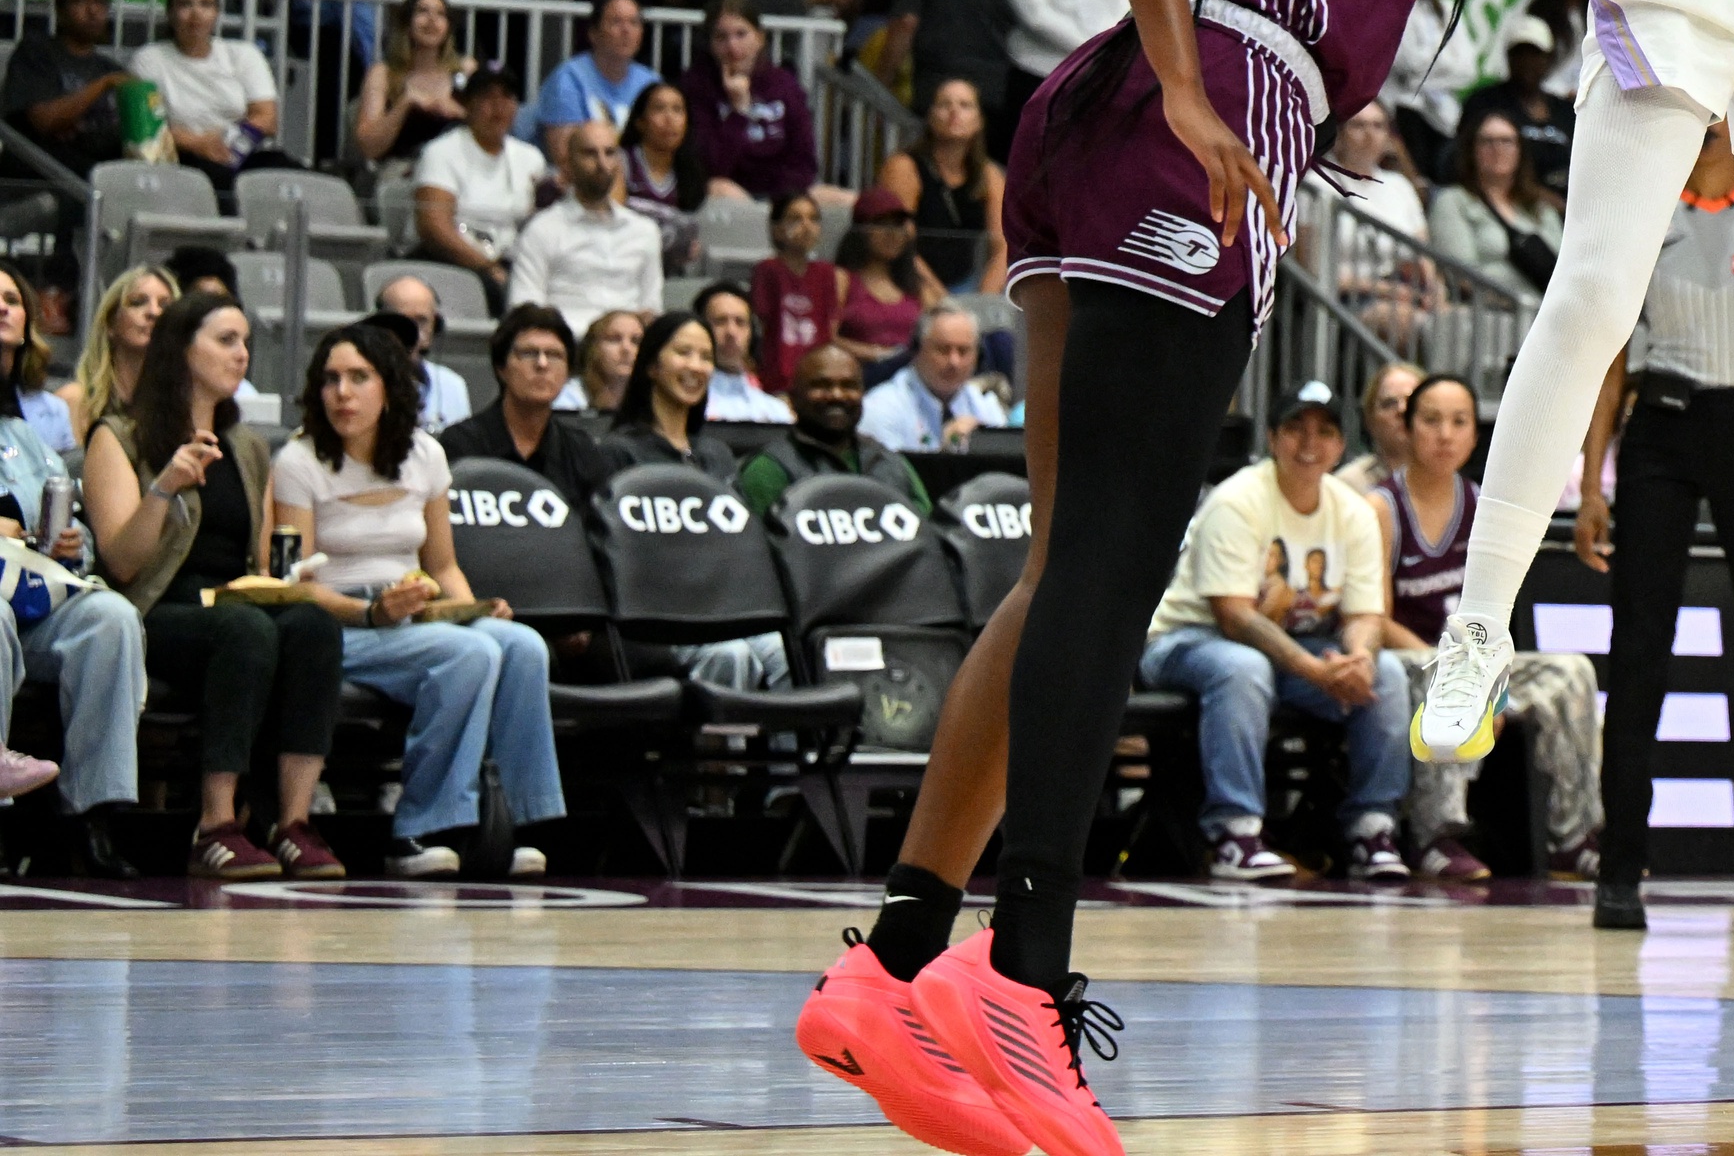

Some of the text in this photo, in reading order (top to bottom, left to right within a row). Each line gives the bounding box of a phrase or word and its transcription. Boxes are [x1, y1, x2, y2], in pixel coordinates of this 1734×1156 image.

[447, 489, 529, 527] CIBC
[618, 494, 709, 534] CIBC
[796, 507, 884, 545] CIBC
[1468, 630, 1484, 638] YBL
